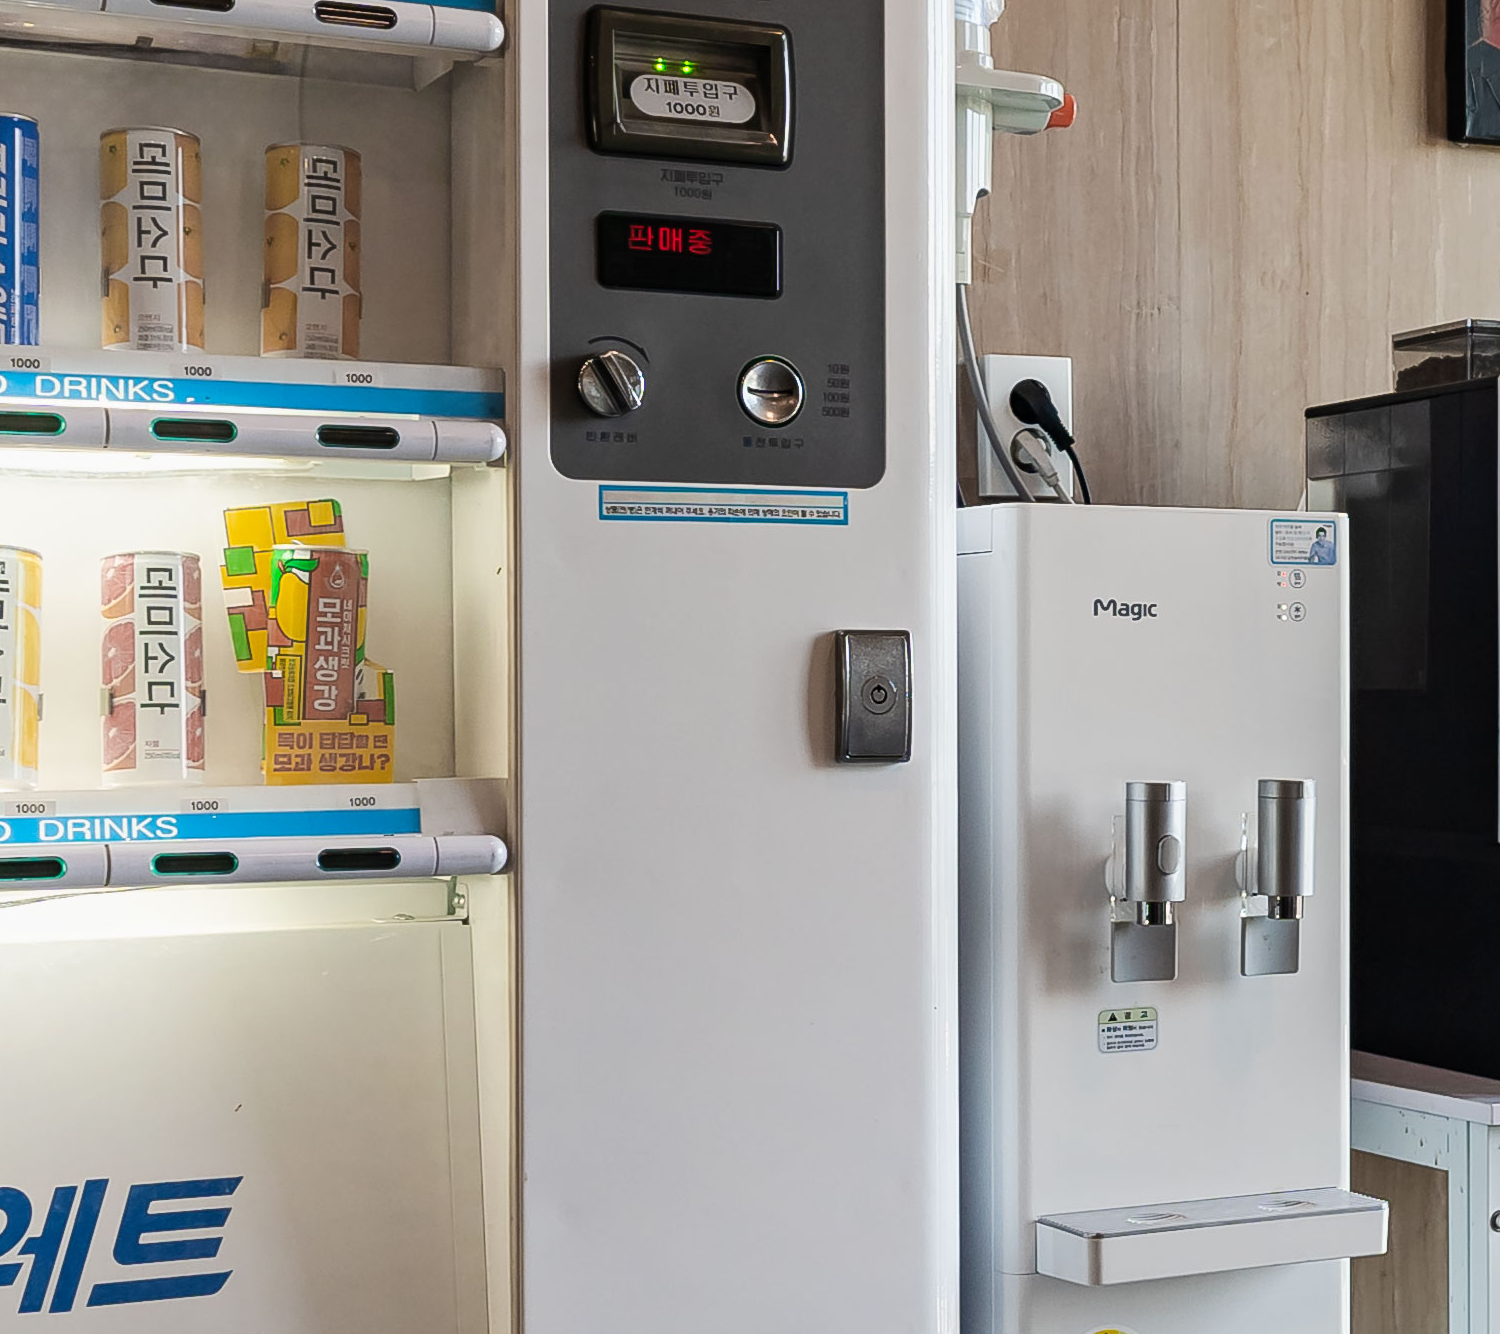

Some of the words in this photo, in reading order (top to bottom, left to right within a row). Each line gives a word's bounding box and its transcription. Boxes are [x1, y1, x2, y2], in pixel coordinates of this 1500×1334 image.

[643, 77, 739, 101] 지폐투입구
[665, 101, 720, 118] 1000원
[674, 186, 713, 200] 1000원
[131, 141, 173, 290] 데미소다
[301, 156, 342, 300] 데미소다
[628, 223, 713, 255] 판매중
[10, 357, 40, 369] 1000
[184, 366, 212, 377] 1000
[345, 373, 373, 384] 1000
[36, 375, 175, 403] DRINKS
[1093, 598, 1158, 621] Magic
[138, 566, 180, 716] 데미소다
[313, 597, 342, 712] 모과생강
[277, 732, 314, 750] 목이
[273, 753, 313, 772] 모과
[319, 752, 391, 772] 생강나?
[15, 803, 46, 814] 1000
[190, 800, 218, 811] 1000
[348, 796, 376, 807] 1000
[38, 816, 179, 842] DRINKS
